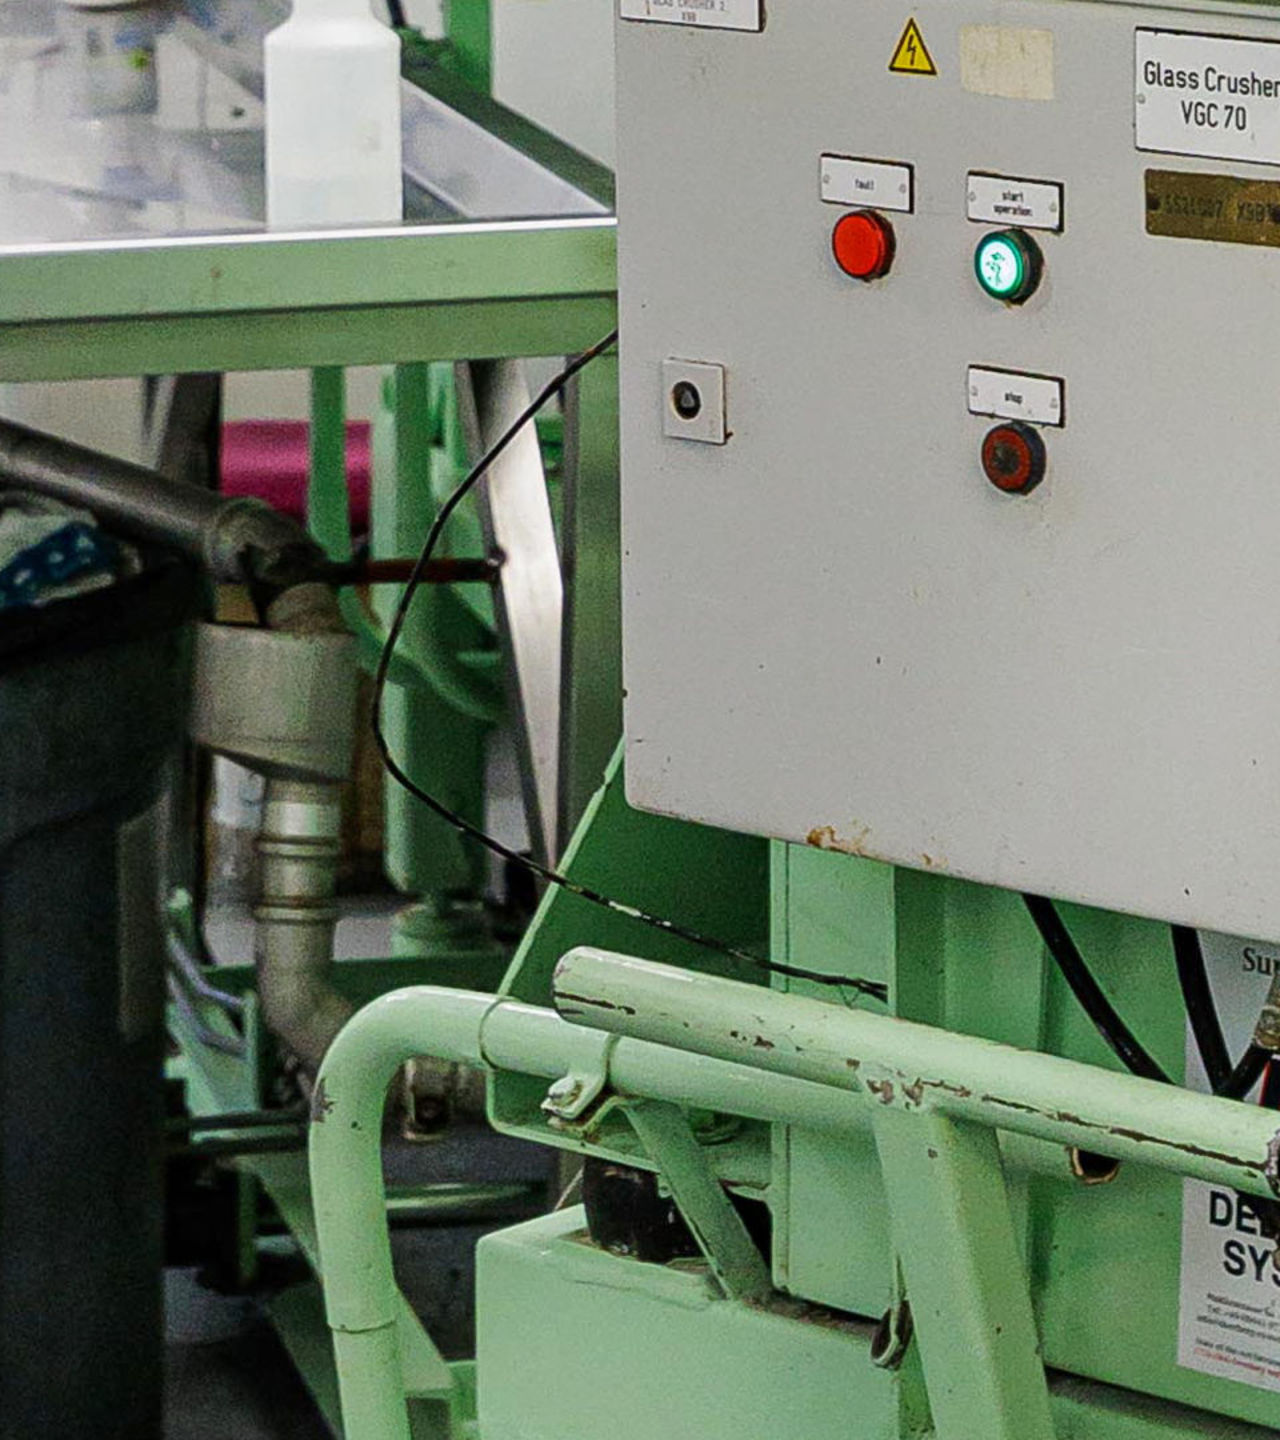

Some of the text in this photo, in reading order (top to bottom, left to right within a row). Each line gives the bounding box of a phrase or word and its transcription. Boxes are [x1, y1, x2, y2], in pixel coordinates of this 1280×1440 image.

[1144, 61, 1199, 90] Glass
[1181, 100, 1247, 131] VGC 70
[855, 178, 874, 191] fault
[1002, 190, 1024, 203] start
[993, 203, 1033, 217] operation
[1004, 391, 1023, 405] stop
